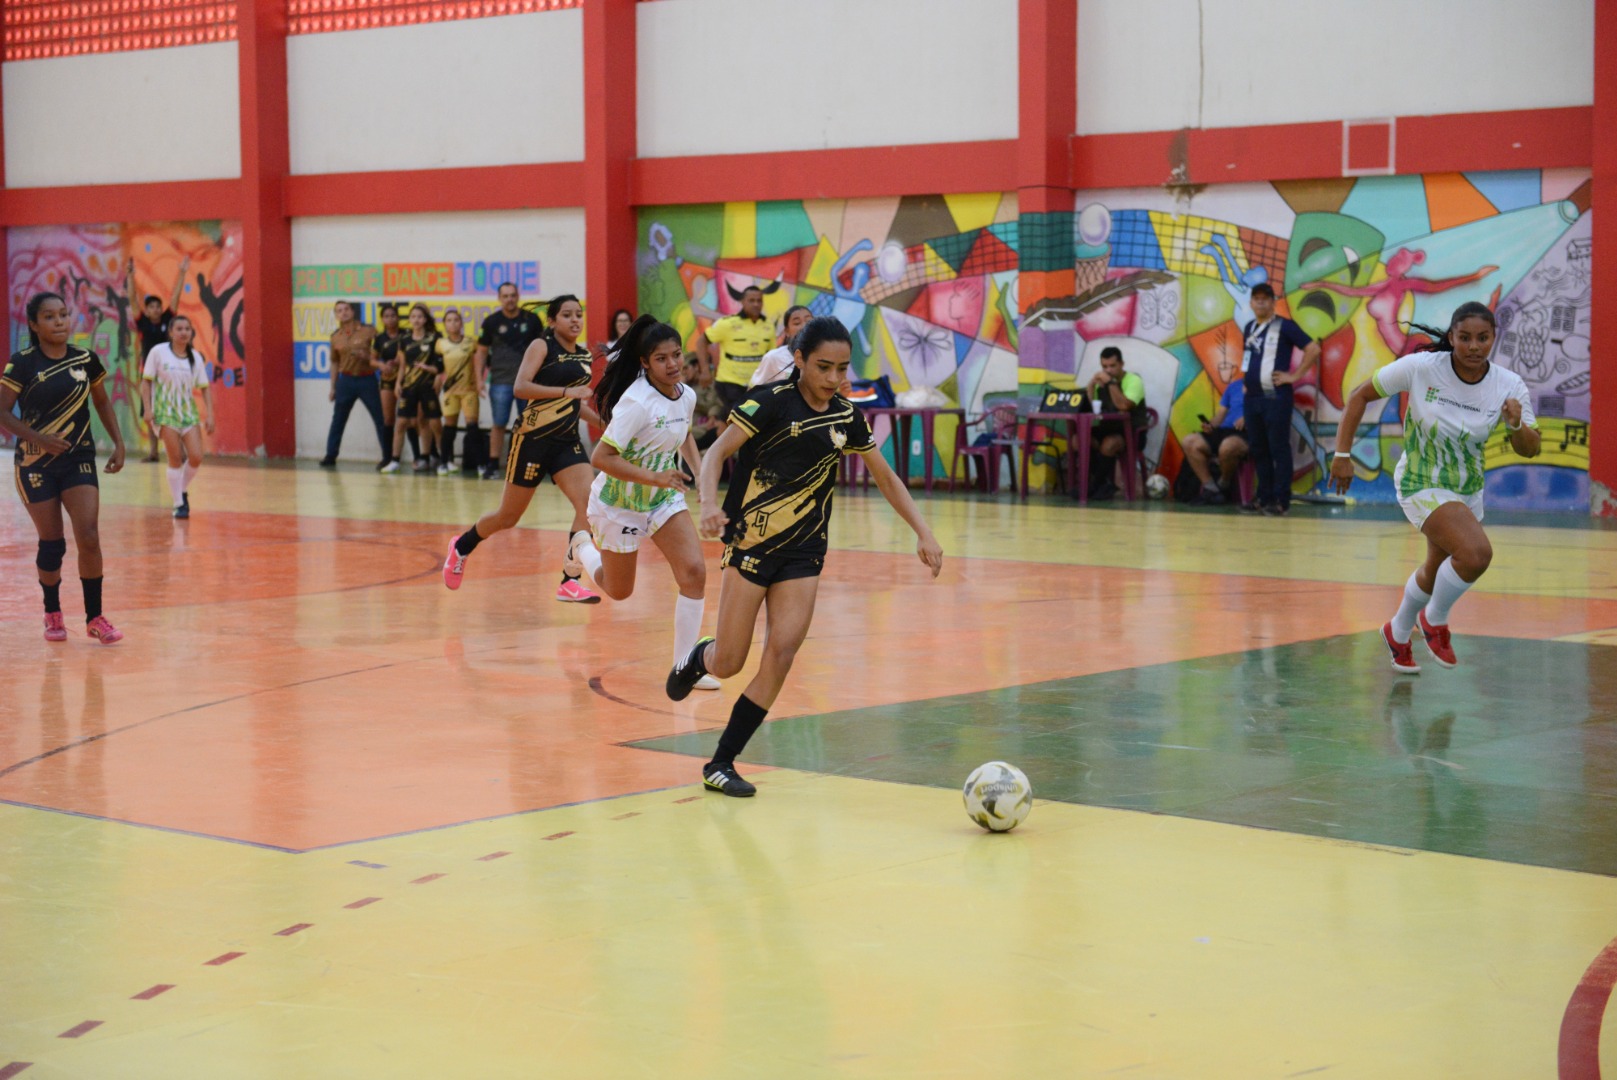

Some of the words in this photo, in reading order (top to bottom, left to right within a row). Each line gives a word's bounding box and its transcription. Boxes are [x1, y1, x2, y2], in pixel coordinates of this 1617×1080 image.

[295, 267, 379, 294] PRATIQUE
[387, 266, 449, 292] DANCE
[456, 260, 537, 292] TOQUE
[299, 343, 331, 374] JO
[754, 510, 770, 537] 9
